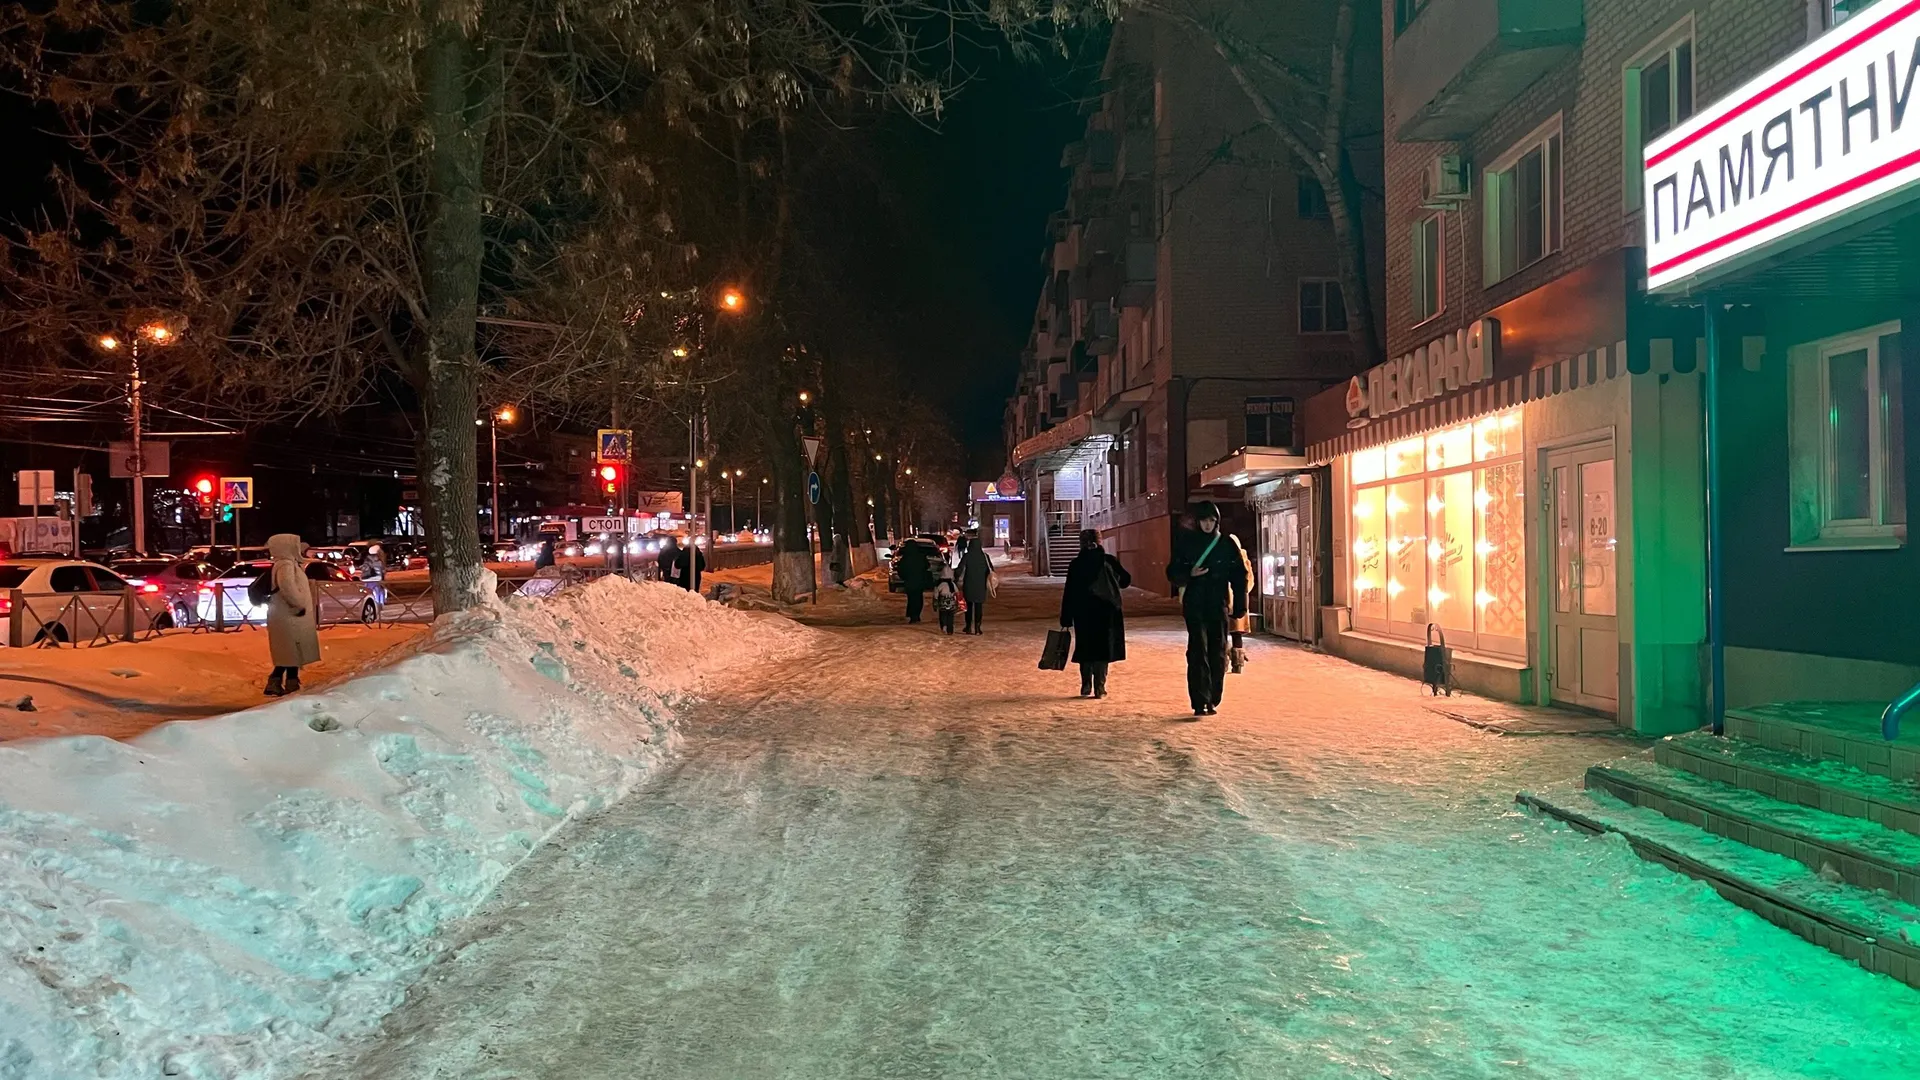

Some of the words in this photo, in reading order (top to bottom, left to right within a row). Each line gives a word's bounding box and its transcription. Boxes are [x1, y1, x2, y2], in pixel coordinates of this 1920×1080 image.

[1368, 319, 1493, 418] ПЕКАРНЯ
[589, 519, 621, 530] СТОП
[1590, 517, 1608, 536] 8-20
